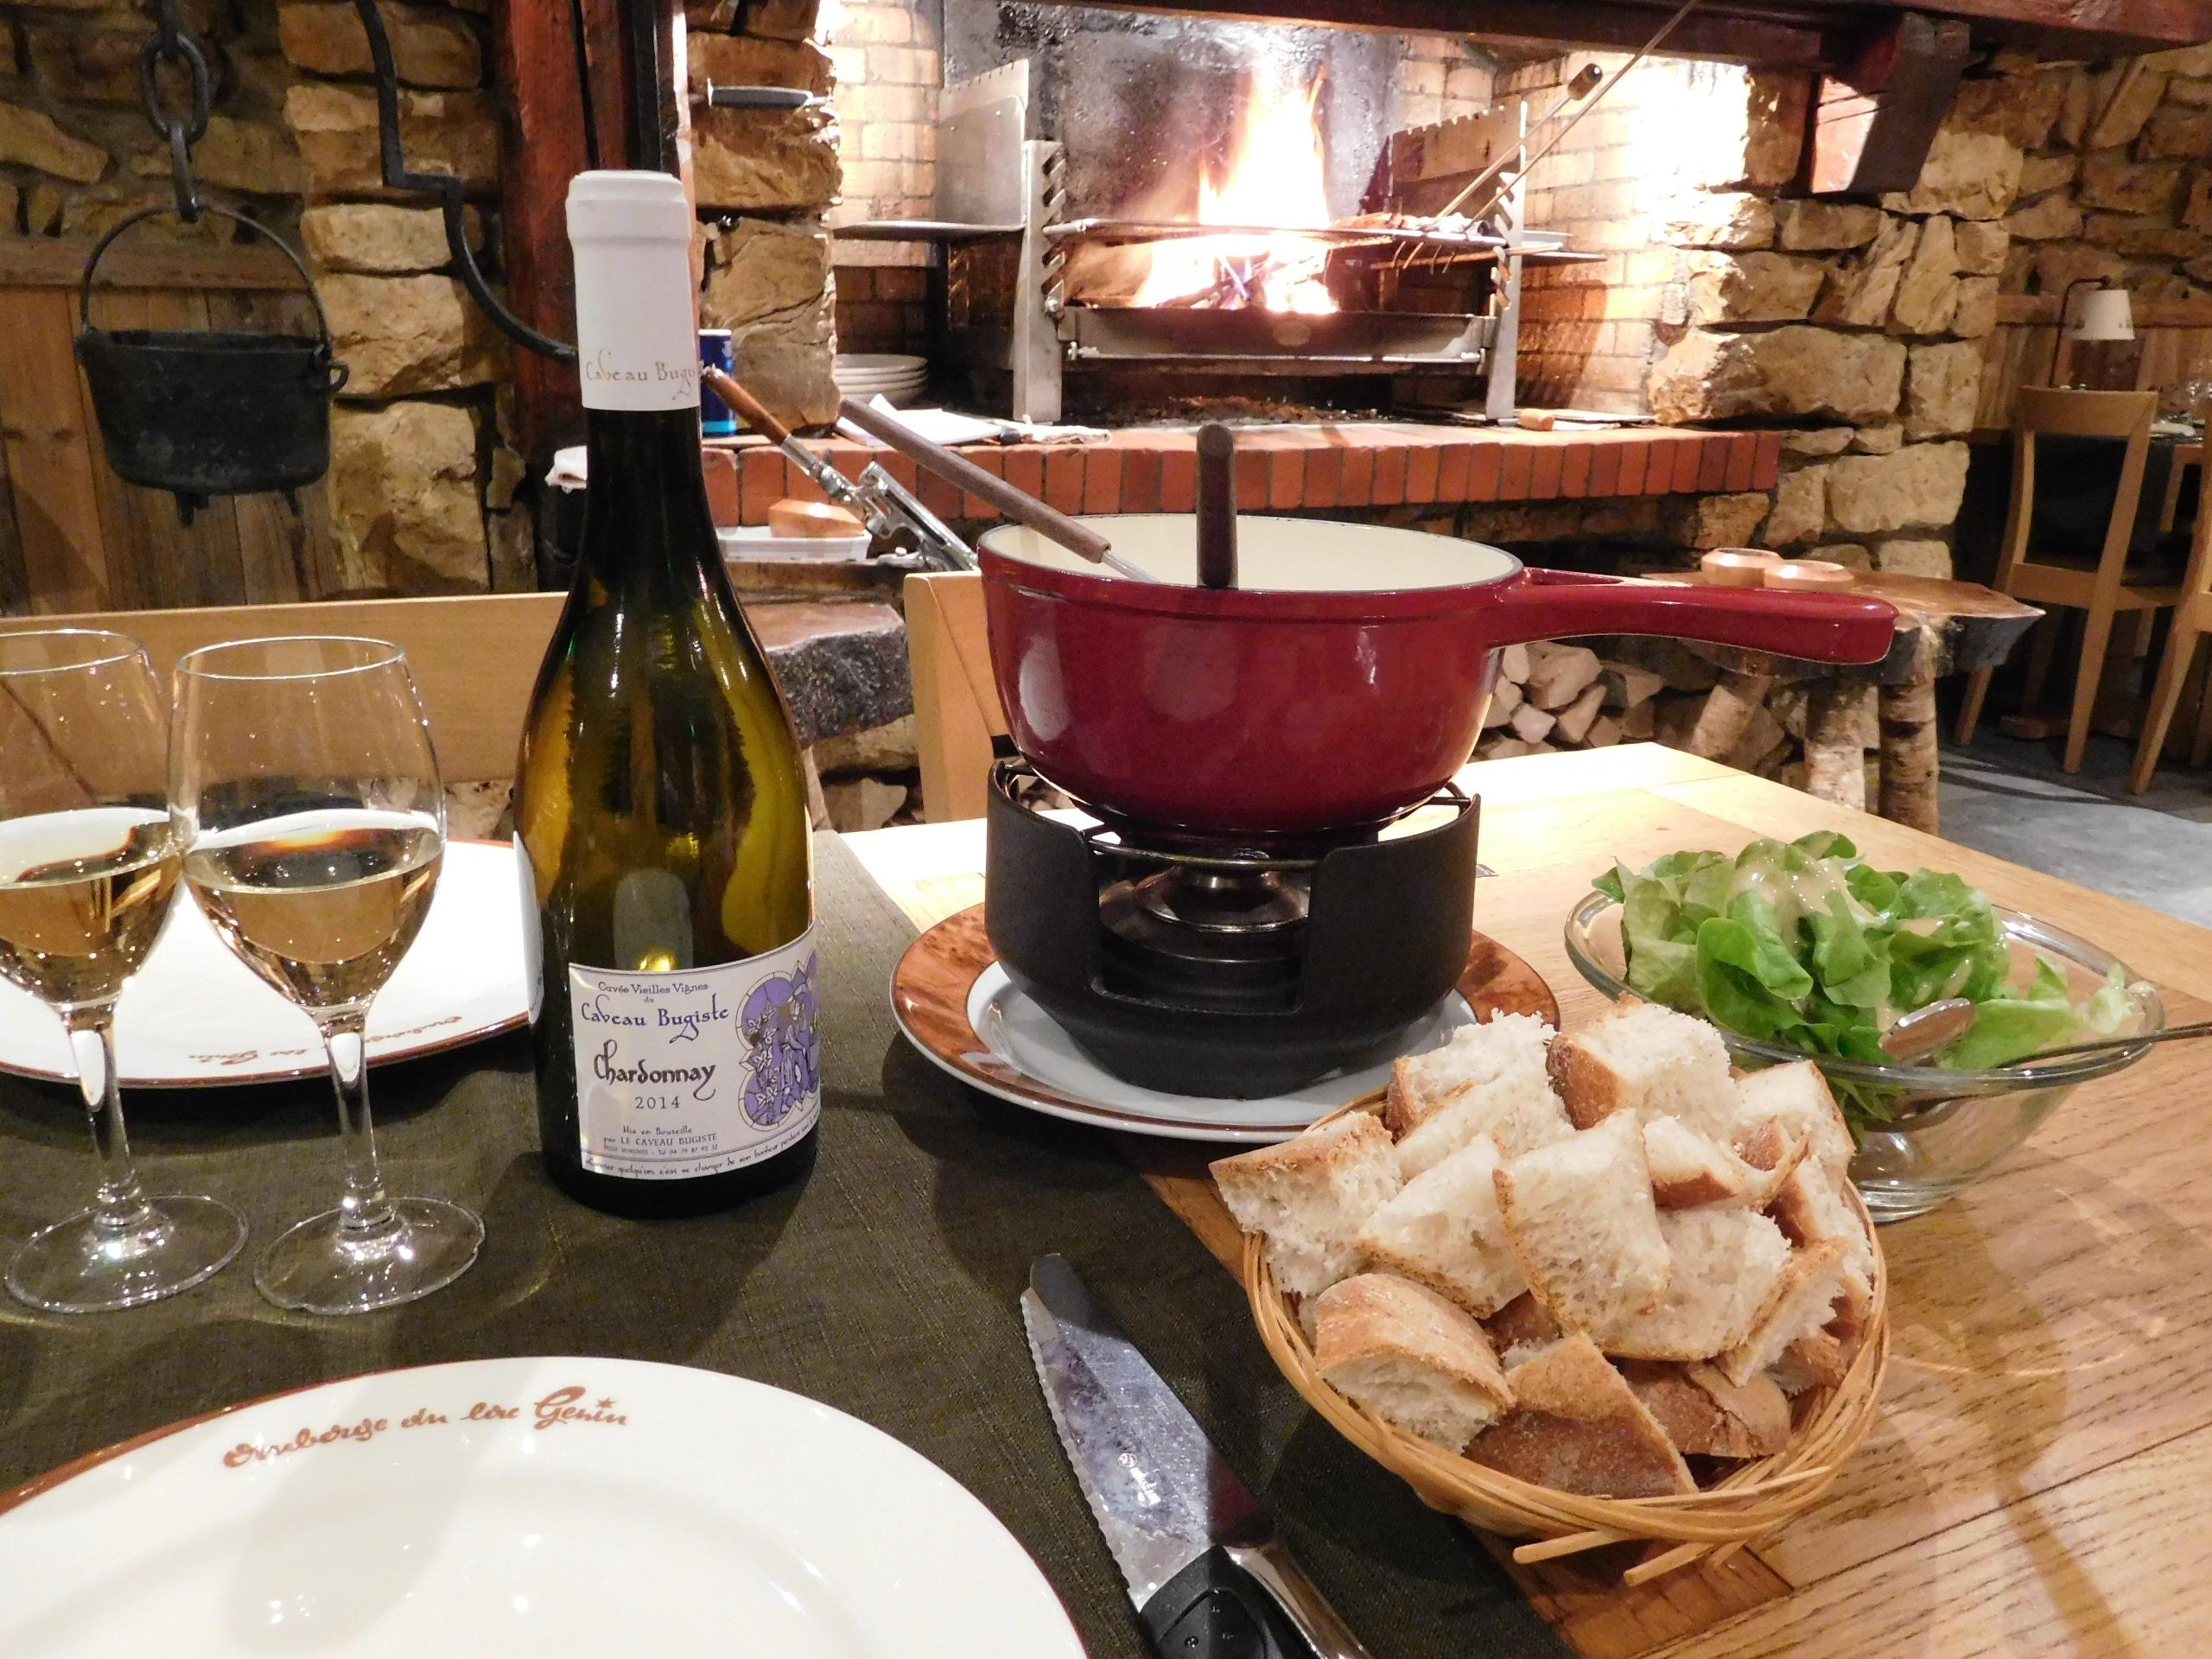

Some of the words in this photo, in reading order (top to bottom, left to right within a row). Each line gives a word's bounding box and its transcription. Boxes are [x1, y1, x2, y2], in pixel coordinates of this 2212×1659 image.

[598, 981, 629, 994] Cuvée
[631, 983, 671, 995] Vieilles
[672, 982, 709, 995] Vignes
[581, 994, 647, 1027] Caveau
[657, 993, 729, 1044] Bugiste
[594, 1039, 716, 1101] Chardonnay
[634, 1096, 681, 1109] 2014
[623, 1125, 637, 1135] Mis
[656, 1125, 692, 1135] Bouteille
[620, 1136, 630, 1145] LE
[635, 1137, 673, 1147] CAVEAU
[678, 1133, 717, 1145] BUGISTE
[533, 1385, 627, 1430] Genin
